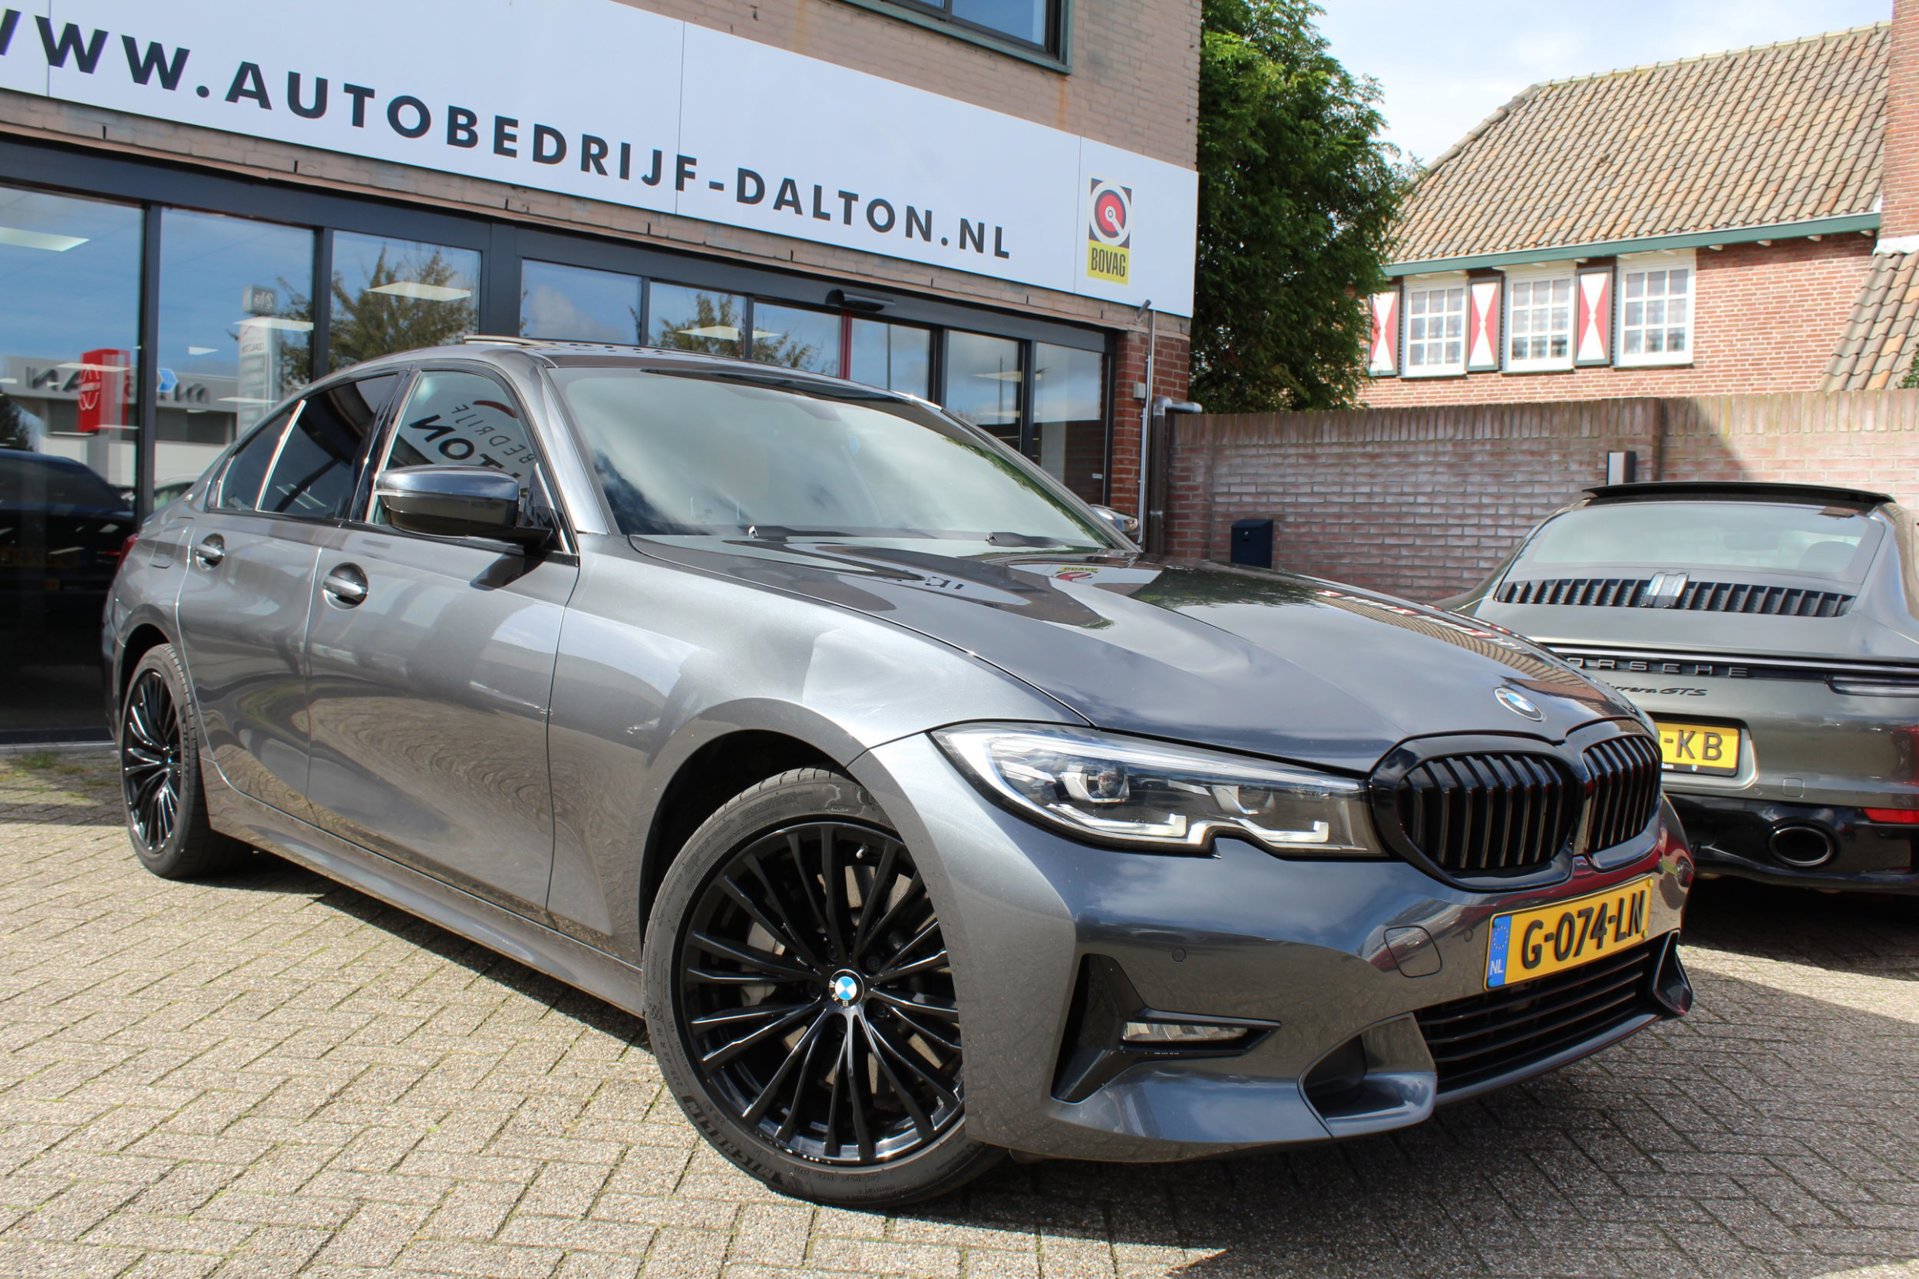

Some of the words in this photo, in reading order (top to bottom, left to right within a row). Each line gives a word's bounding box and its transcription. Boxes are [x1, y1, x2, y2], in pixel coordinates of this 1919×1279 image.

[0, 8, 1010, 260] WW.AUTOBEDRIJF-DALTON.NL
[1091, 247, 1127, 278] BOVAG
[1567, 656, 1749, 678] ORSCHE
[1660, 687, 1709, 697] GTS
[1658, 730, 1723, 761] -KB
[1521, 889, 1647, 970] G-074-LN
[1489, 959, 1504, 975] NL
[684, 1096, 778, 1181] MICHELIN
